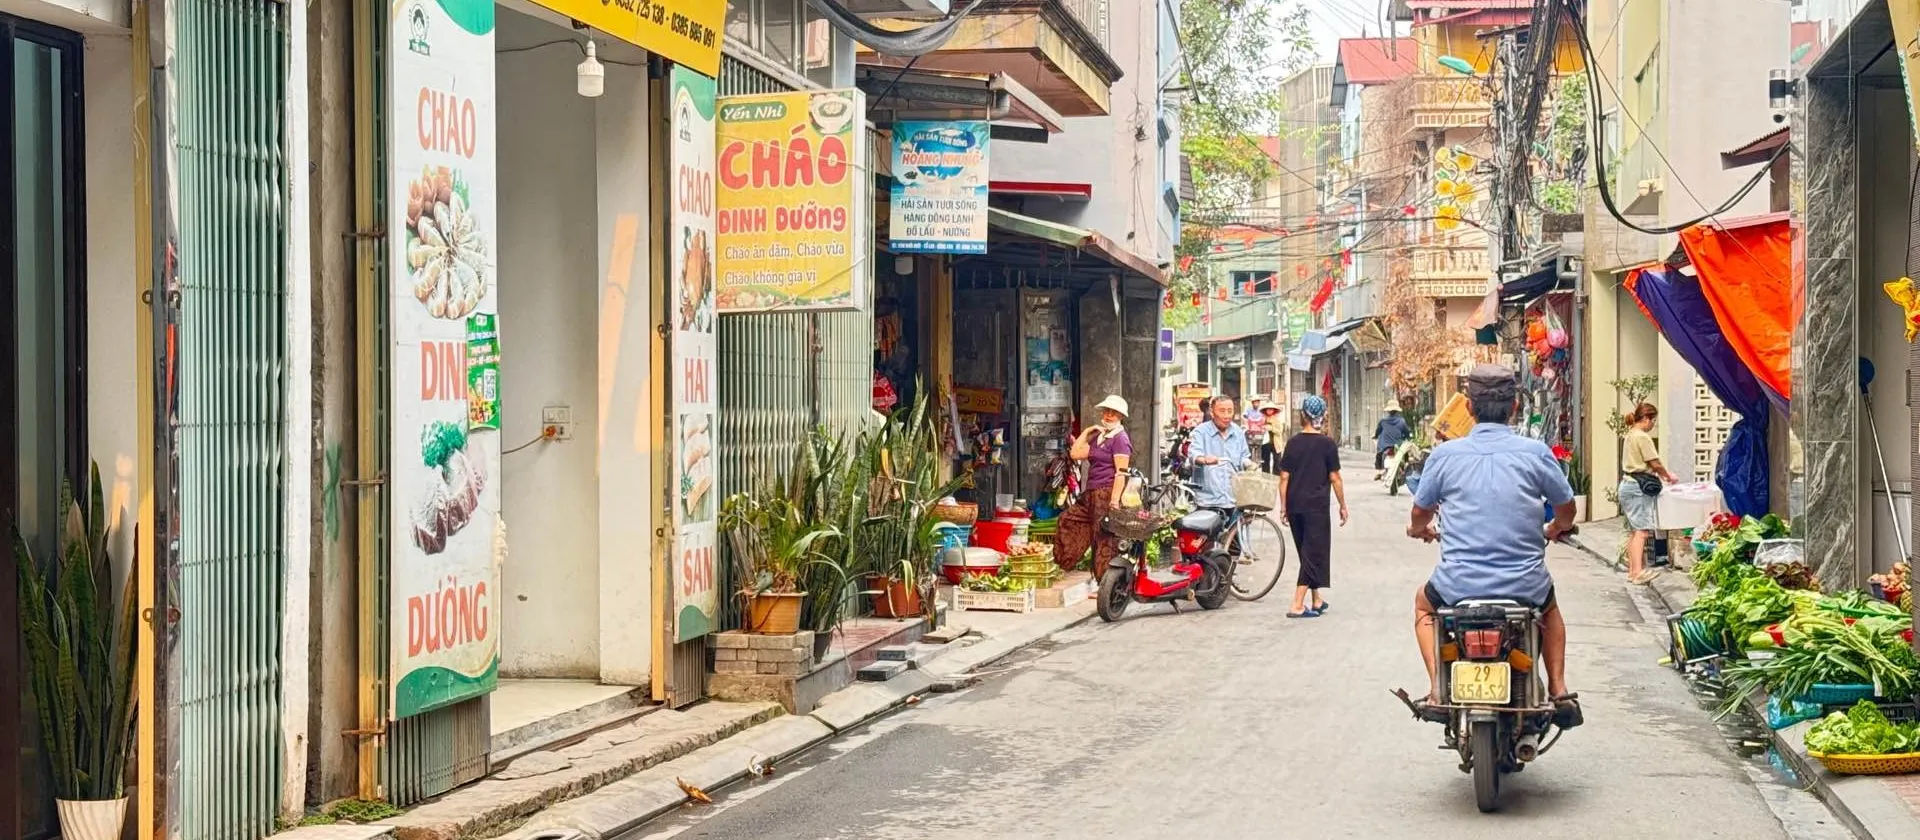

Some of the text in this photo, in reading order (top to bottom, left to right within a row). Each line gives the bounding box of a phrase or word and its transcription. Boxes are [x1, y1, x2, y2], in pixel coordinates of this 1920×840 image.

[652, 3, 665, 25] 138
[417, 75, 477, 160] CHÁO
[724, 103, 783, 121] Yến Nhi
[719, 124, 847, 190] CHÁO
[680, 155, 711, 217] CHÁO
[718, 208, 767, 234] DINH
[724, 245, 750, 260] Cháo
[796, 241, 822, 257] Cháo
[407, 574, 488, 658] DƯỠNG
[1474, 665, 1491, 682] 29
